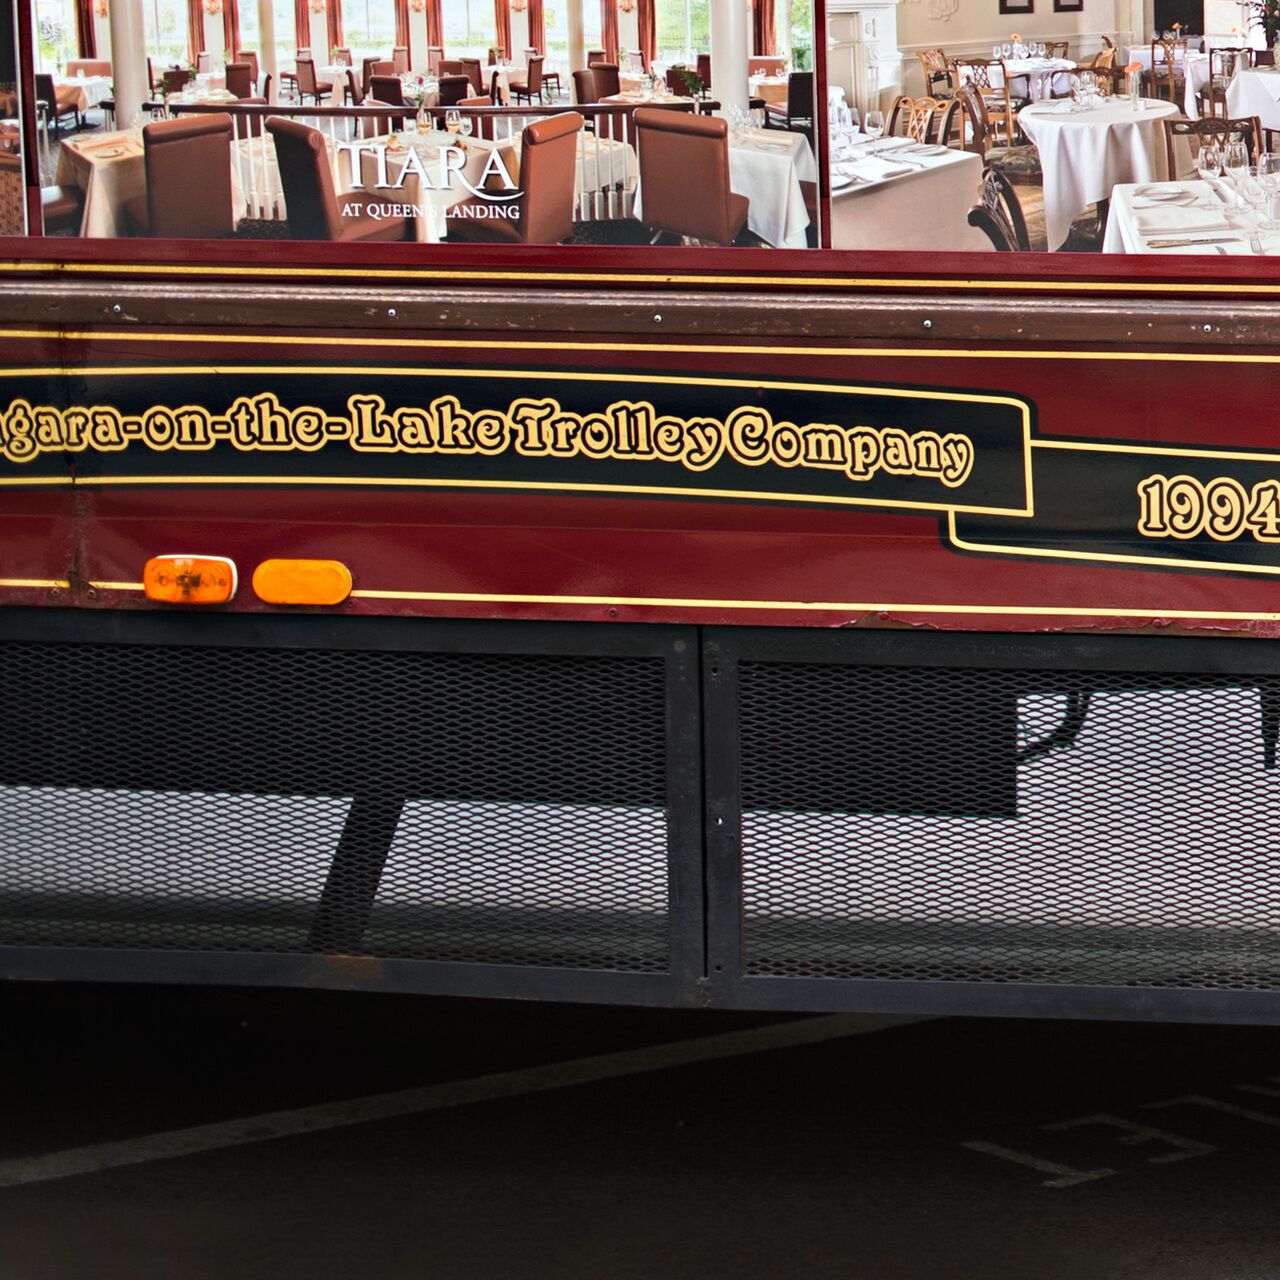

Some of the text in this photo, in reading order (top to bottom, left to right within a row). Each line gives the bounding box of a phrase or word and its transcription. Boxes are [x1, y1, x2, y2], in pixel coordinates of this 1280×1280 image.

[337, 145, 524, 201] TIARA
[342, 203, 362, 217] AT
[443, 204, 520, 219] LANDING
[0, 392, 510, 464] gara-on-the-Lake
[724, 405, 975, 488] Company
